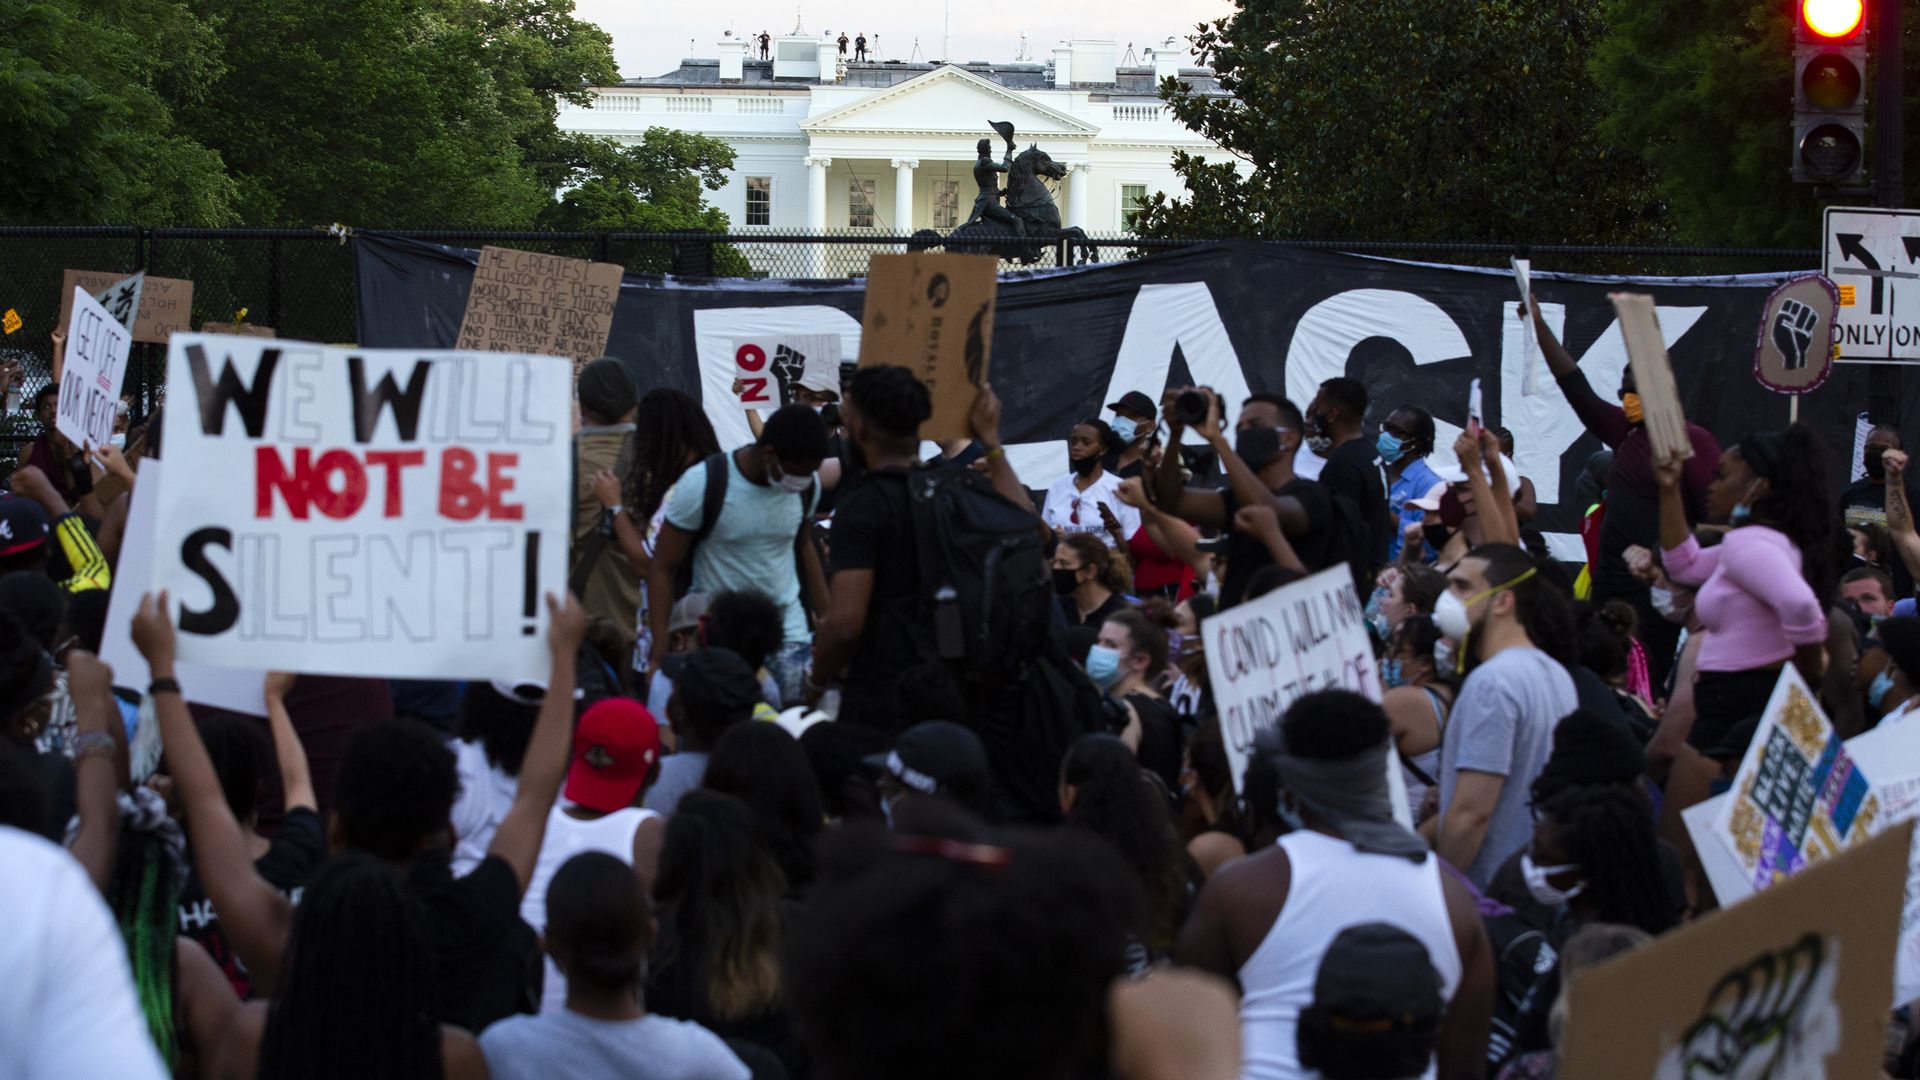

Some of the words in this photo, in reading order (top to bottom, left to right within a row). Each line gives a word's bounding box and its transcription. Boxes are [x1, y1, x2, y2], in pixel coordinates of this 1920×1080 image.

[476, 267, 538, 287] ILLUSION
[543, 277, 560, 290] OF
[570, 282, 610, 298] THIS
[482, 249, 509, 269] THE
[515, 252, 590, 281] GREATEST
[466, 312, 487, 324] YOU
[492, 314, 531, 331] THINK
[474, 284, 510, 297] WORLD
[516, 288, 533, 301] IS
[539, 291, 568, 307] THE
[77, 307, 103, 364] GET
[99, 328, 121, 374] OFF
[489, 328, 549, 345] DIFFERENT
[61, 370, 83, 427] OUR
[185, 344, 323, 443] WE
[347, 355, 555, 444] WILL
[736, 344, 770, 402] NO
[254, 446, 426, 520] NOT
[438, 447, 525, 521] BE
[178, 525, 541, 643] SILENT!
[1217, 615, 1281, 683] COVID
